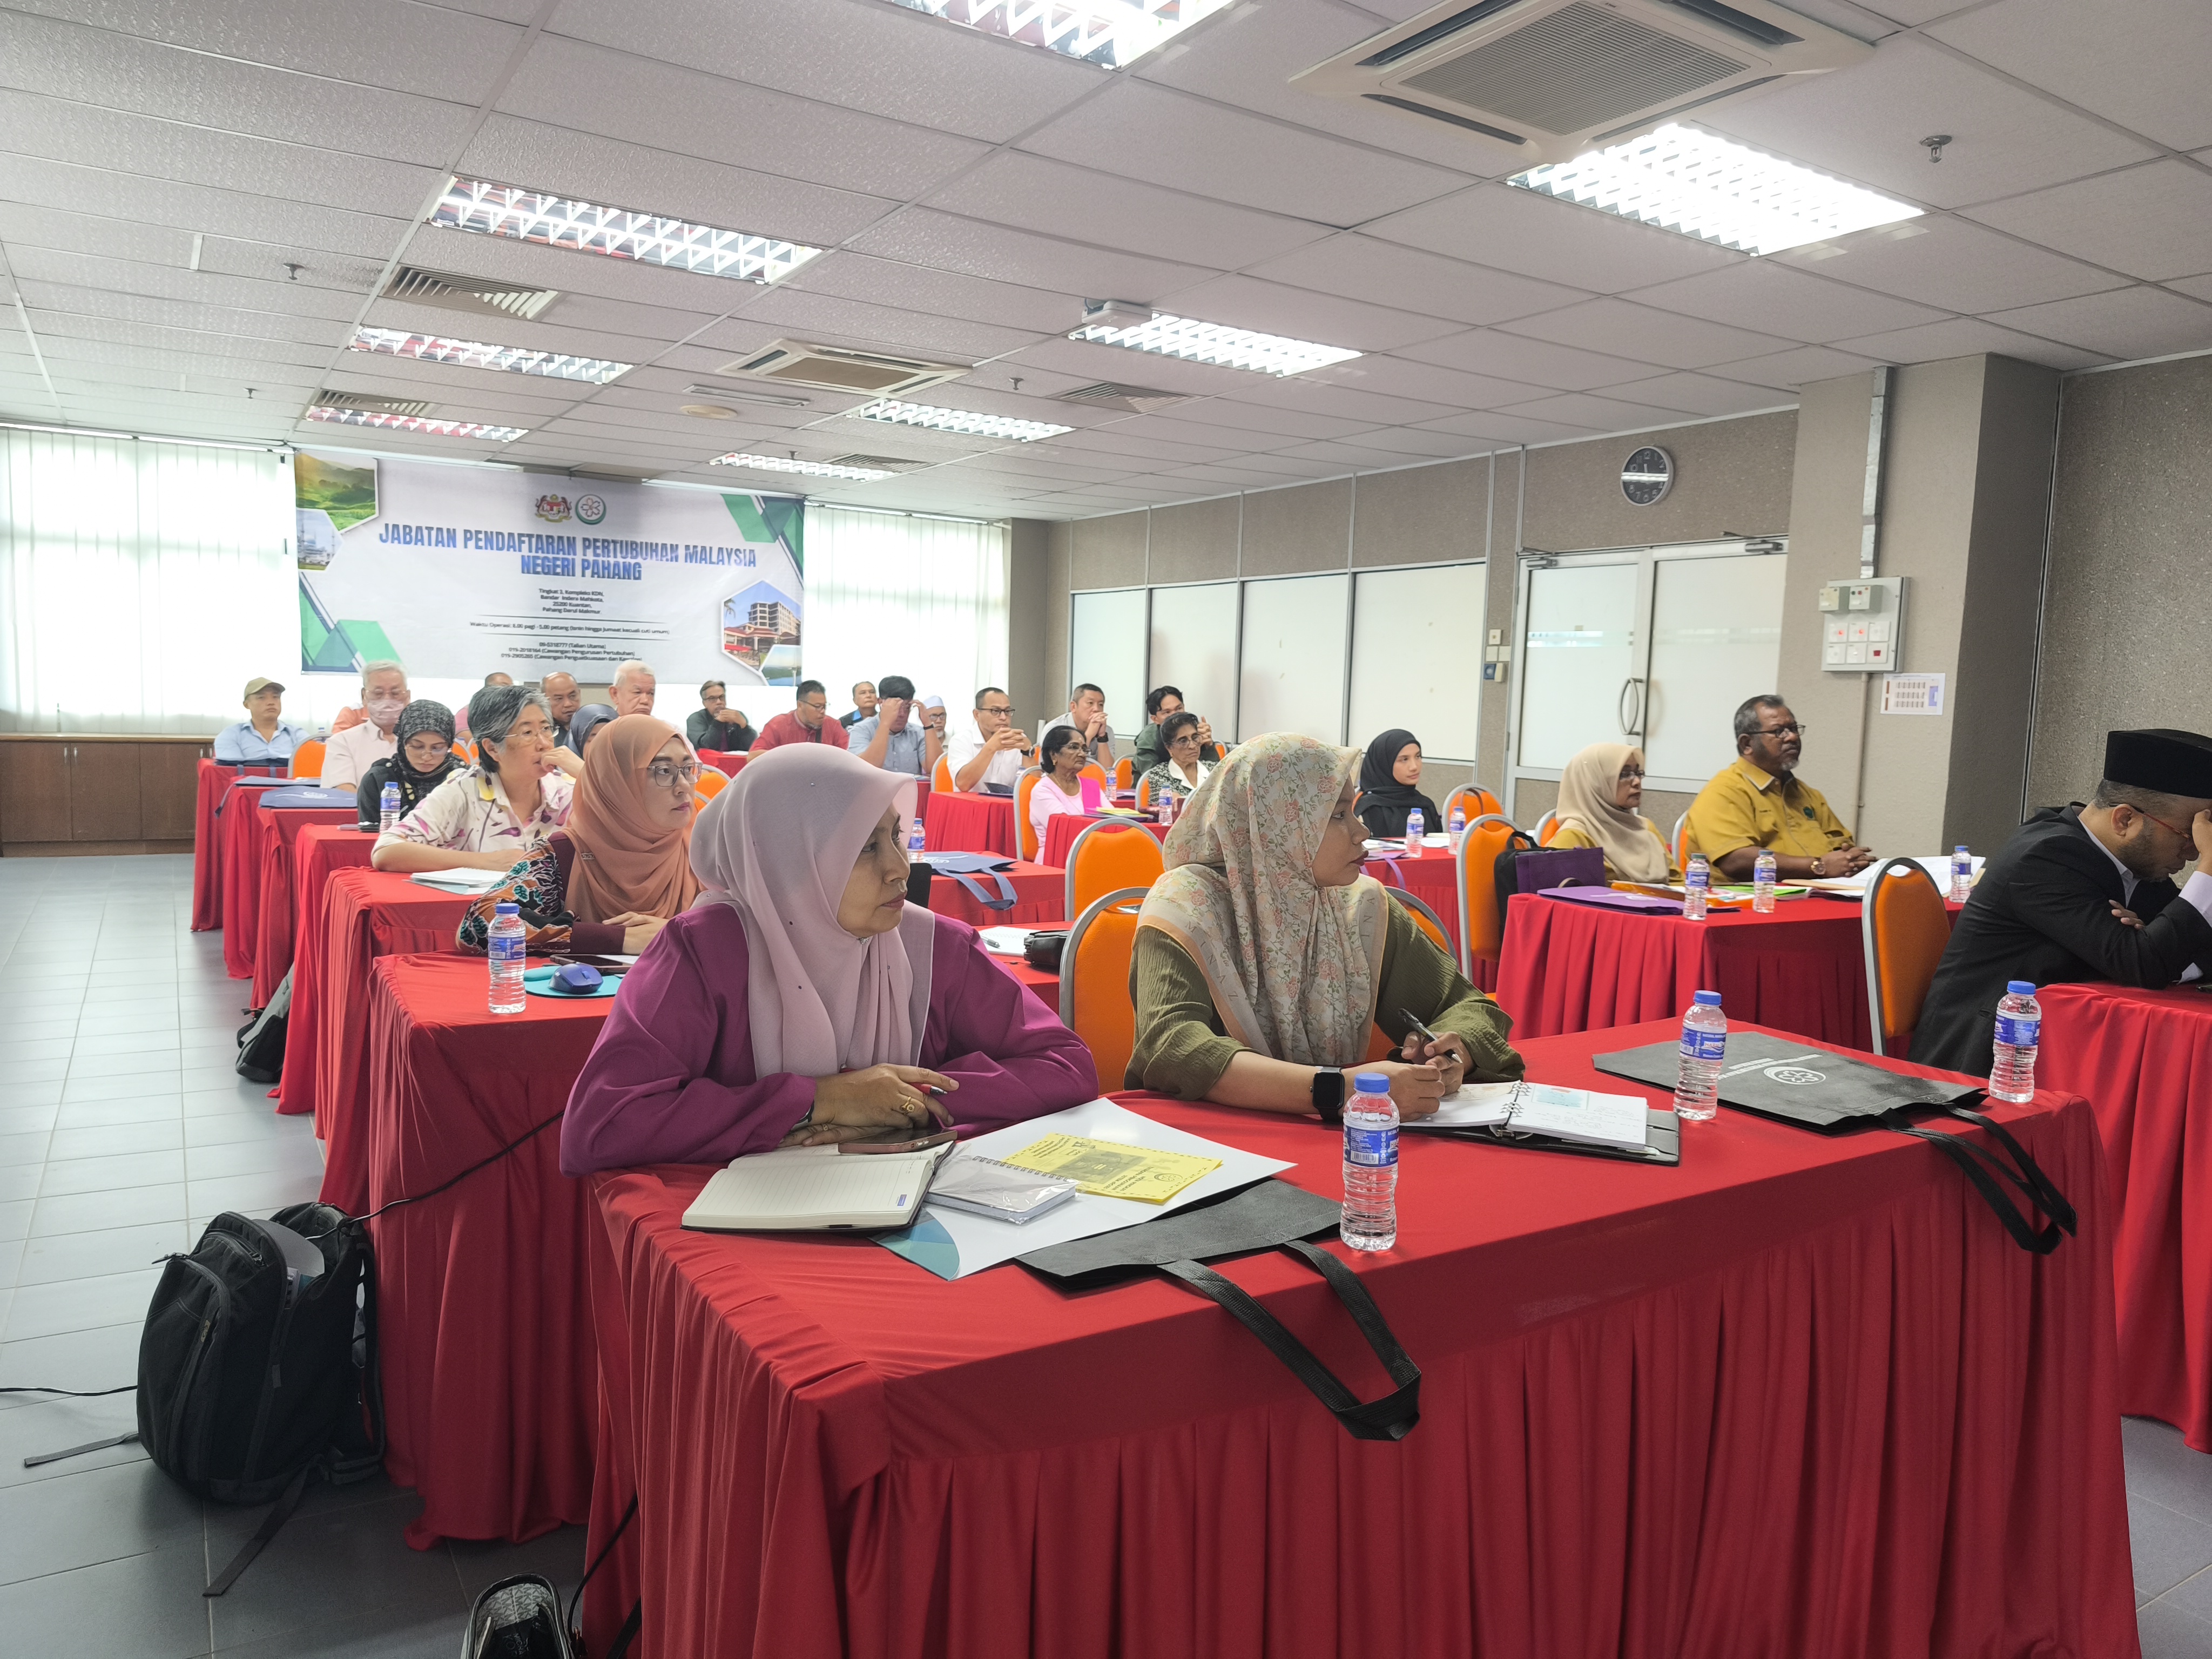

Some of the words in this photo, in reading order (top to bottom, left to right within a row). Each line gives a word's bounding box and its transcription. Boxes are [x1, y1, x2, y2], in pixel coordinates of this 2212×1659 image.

[379, 523, 457, 548] JABATAN
[463, 529, 577, 556] PENDAFTARAN
[582, 537, 679, 562] PERTUBUHAN
[684, 544, 756, 567] MALAYSIA
[521, 555, 576, 577] NEGERI
[581, 558, 642, 580] PAHANG
[1185, 921, 1238, 1001] MINAZ
